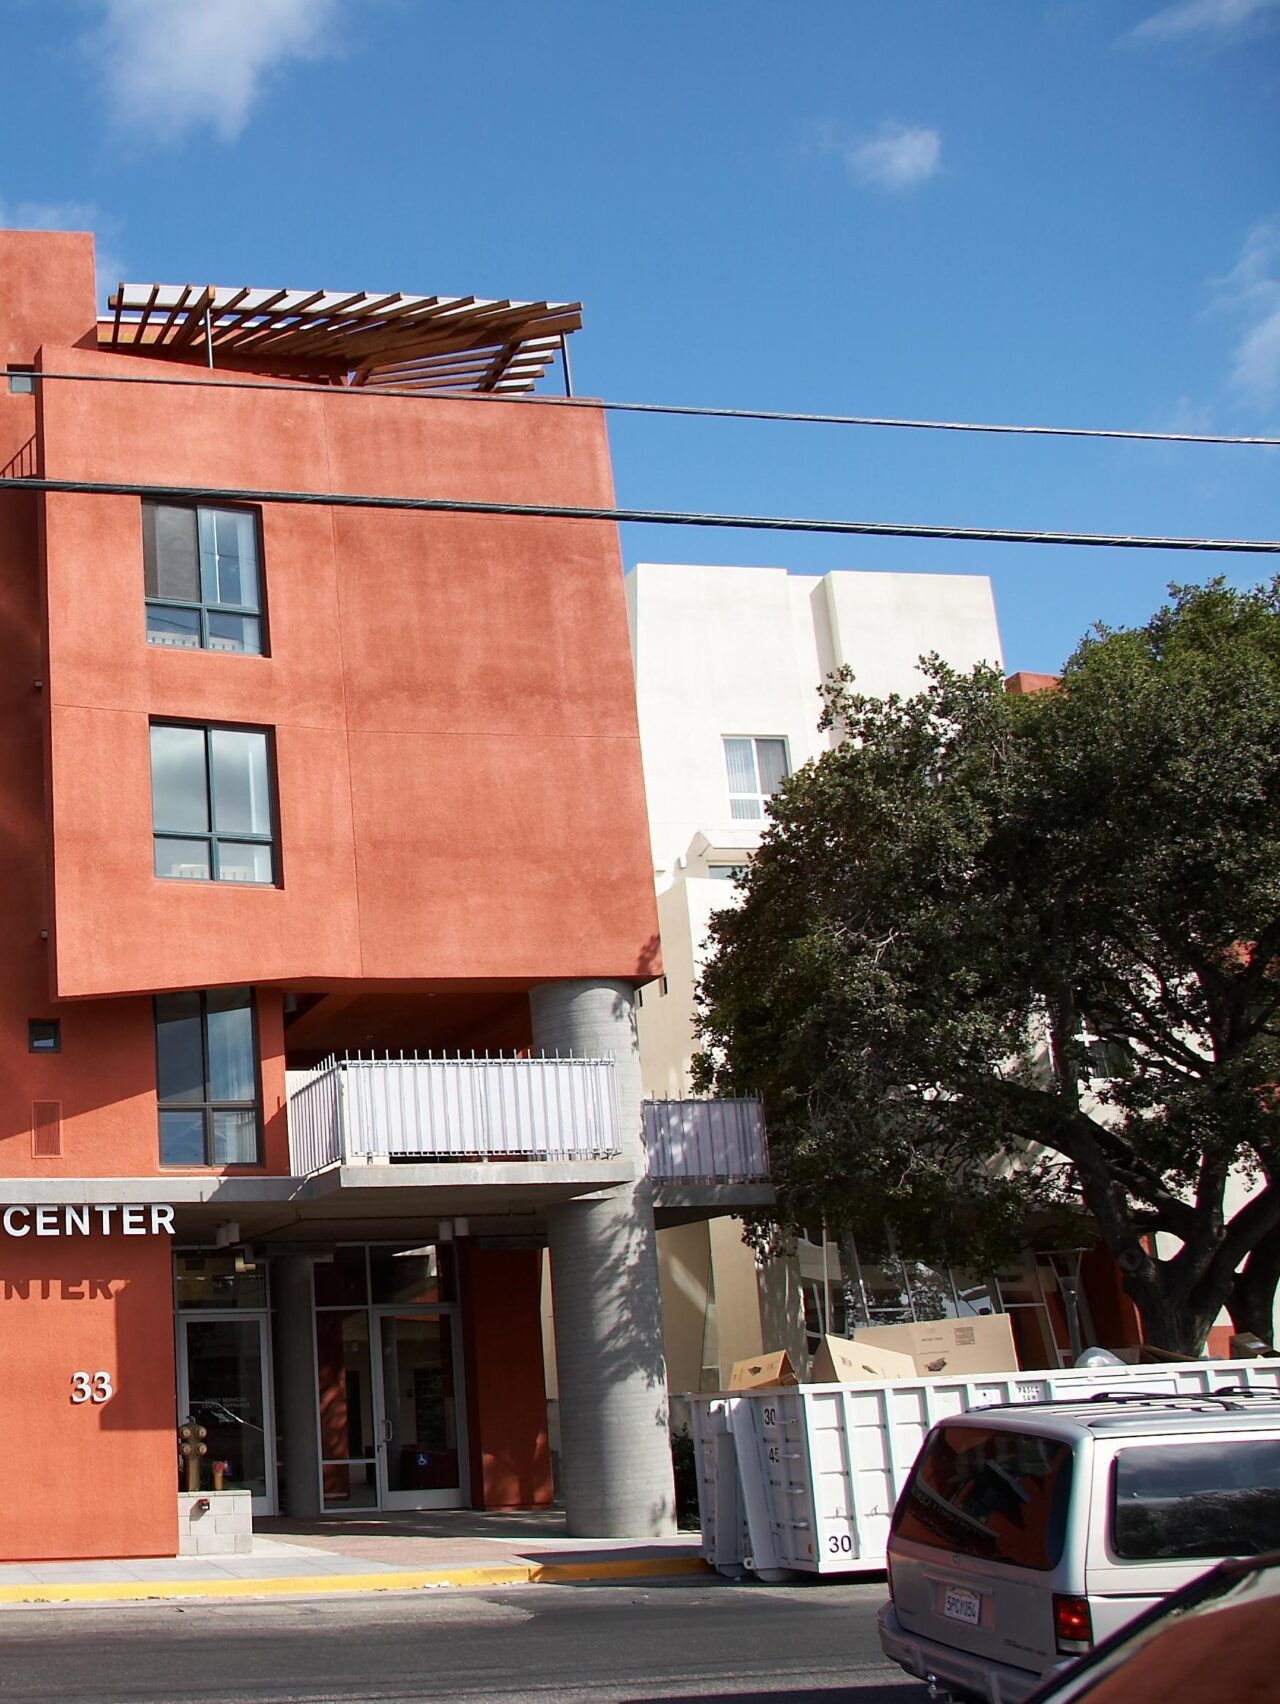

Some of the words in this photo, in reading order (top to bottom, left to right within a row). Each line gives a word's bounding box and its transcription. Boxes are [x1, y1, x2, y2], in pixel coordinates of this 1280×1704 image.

[3, 1204, 176, 1237] CENTER
[71, 1371, 113, 1404] 33
[764, 1408, 776, 1426] 30
[828, 1535, 852, 1554] 30
